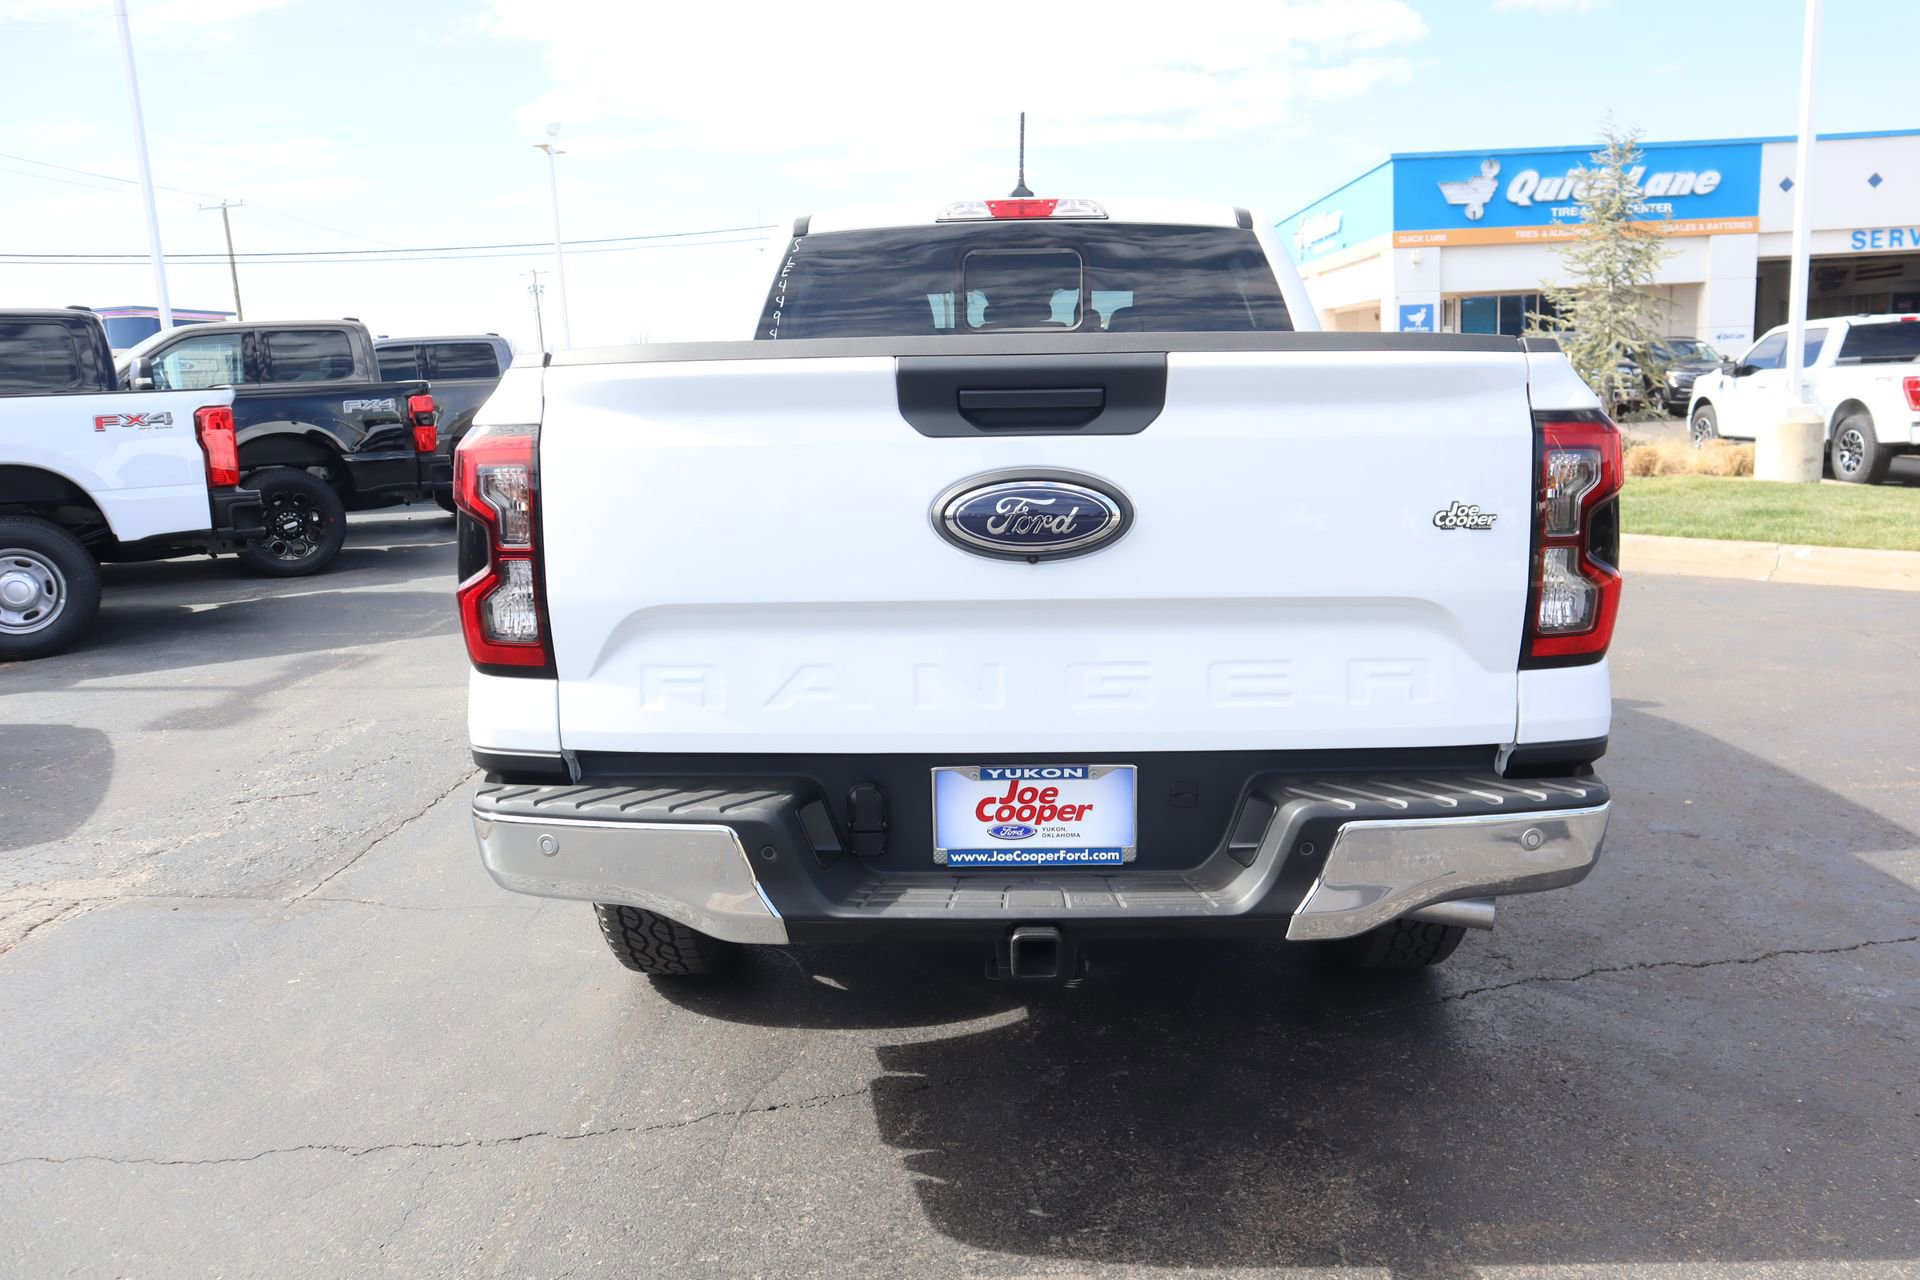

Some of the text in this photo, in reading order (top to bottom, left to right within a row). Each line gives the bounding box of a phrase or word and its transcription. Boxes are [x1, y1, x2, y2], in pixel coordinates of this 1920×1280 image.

[1622, 166, 1721, 198] Lane
[1552, 207, 1579, 217] TIRE
[1626, 203, 1673, 213] CENTER
[343, 398, 397, 414] FX4
[93, 411, 174, 432] FX4
[986, 496, 1080, 535] Ford
[1446, 500, 1480, 517] Joe
[1432, 509, 1497, 528] Cooper
[638, 657, 1437, 711] RANGER
[986, 768, 1083, 779] YUKON
[998, 779, 1059, 805] Joe
[975, 796, 1093, 825] Cooper
[951, 848, 1120, 864] www.JoeCooperFord.com
